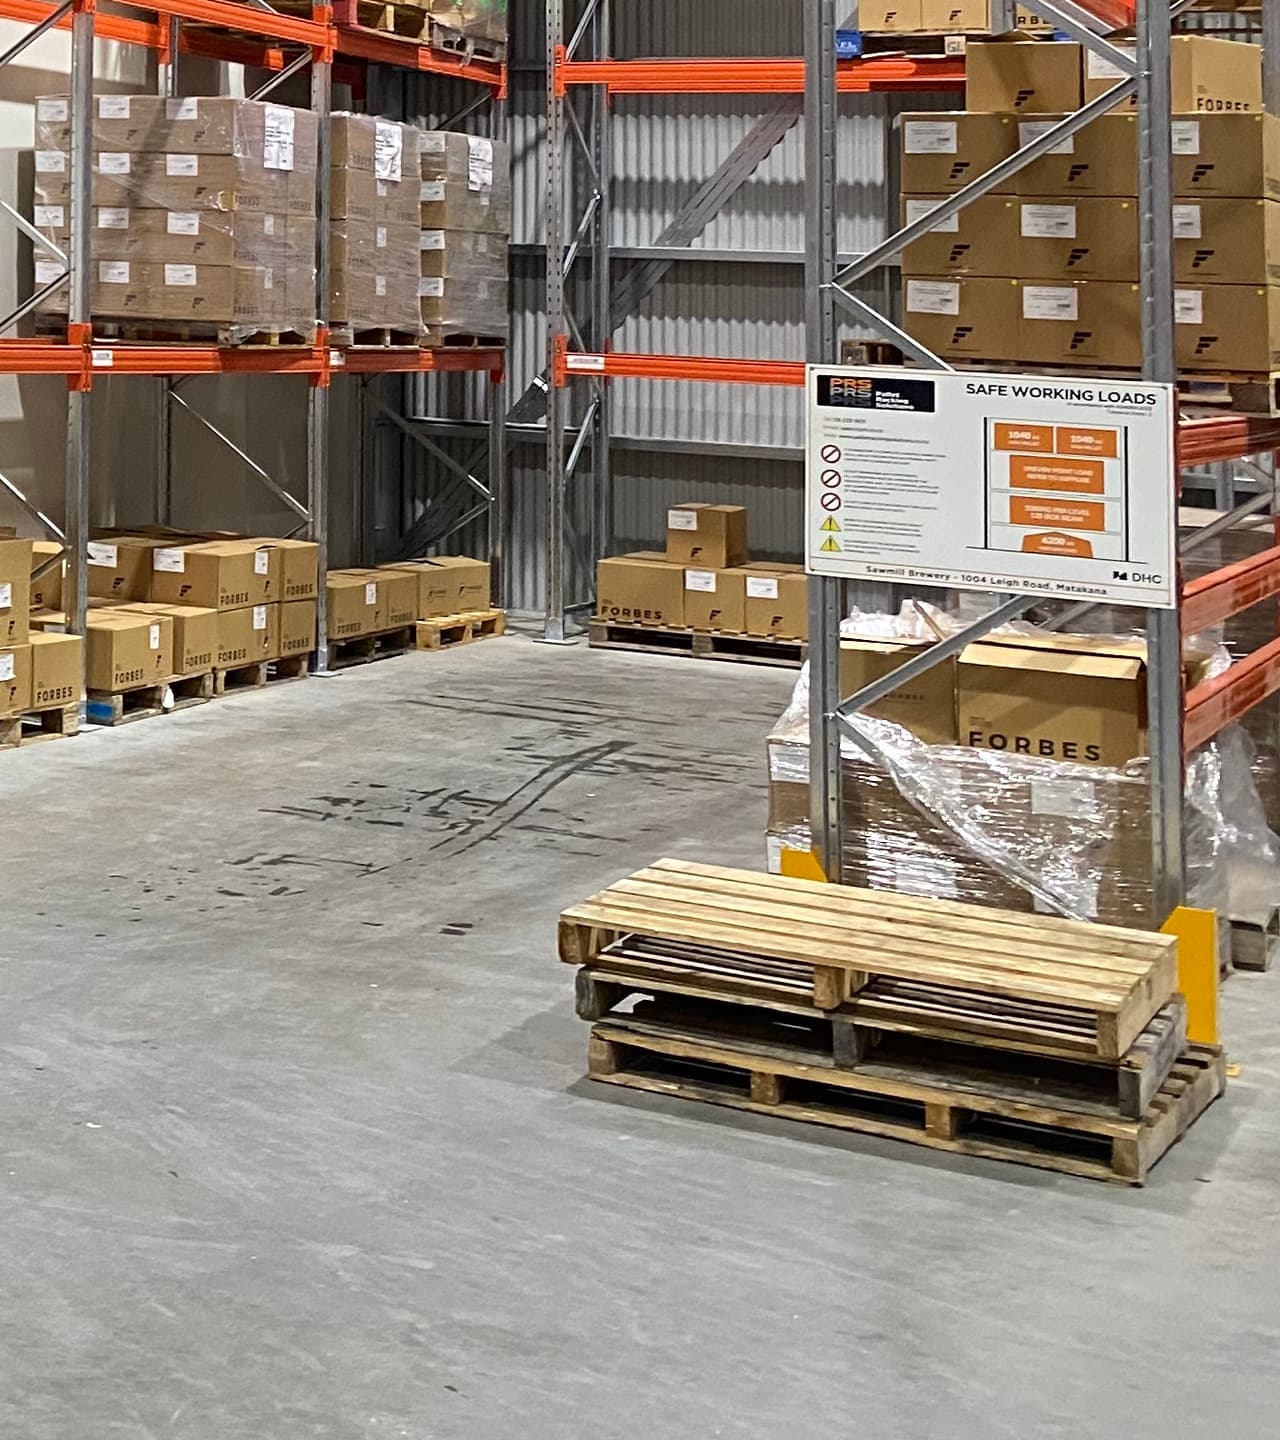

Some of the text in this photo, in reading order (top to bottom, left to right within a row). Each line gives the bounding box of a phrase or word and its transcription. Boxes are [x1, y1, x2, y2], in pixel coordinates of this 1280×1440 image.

[830, 378, 872, 389] PRS
[966, 383, 1157, 405] SAFE WORKING LOADS
[866, 565, 905, 576] Sawmill
[908, 568, 950, 581] Brewery
[990, 577, 1019, 587] Leigh
[1056, 584, 1107, 594] Matakana
[1132, 572, 1162, 584] DHC
[220, 592, 249, 606] FORBES
[601, 605, 663, 620] FORBES
[217, 648, 247, 662] FORBES
[114, 668, 144, 685] FORBES
[37, 686, 73, 703] FORBES
[969, 730, 1101, 761] FORBES
